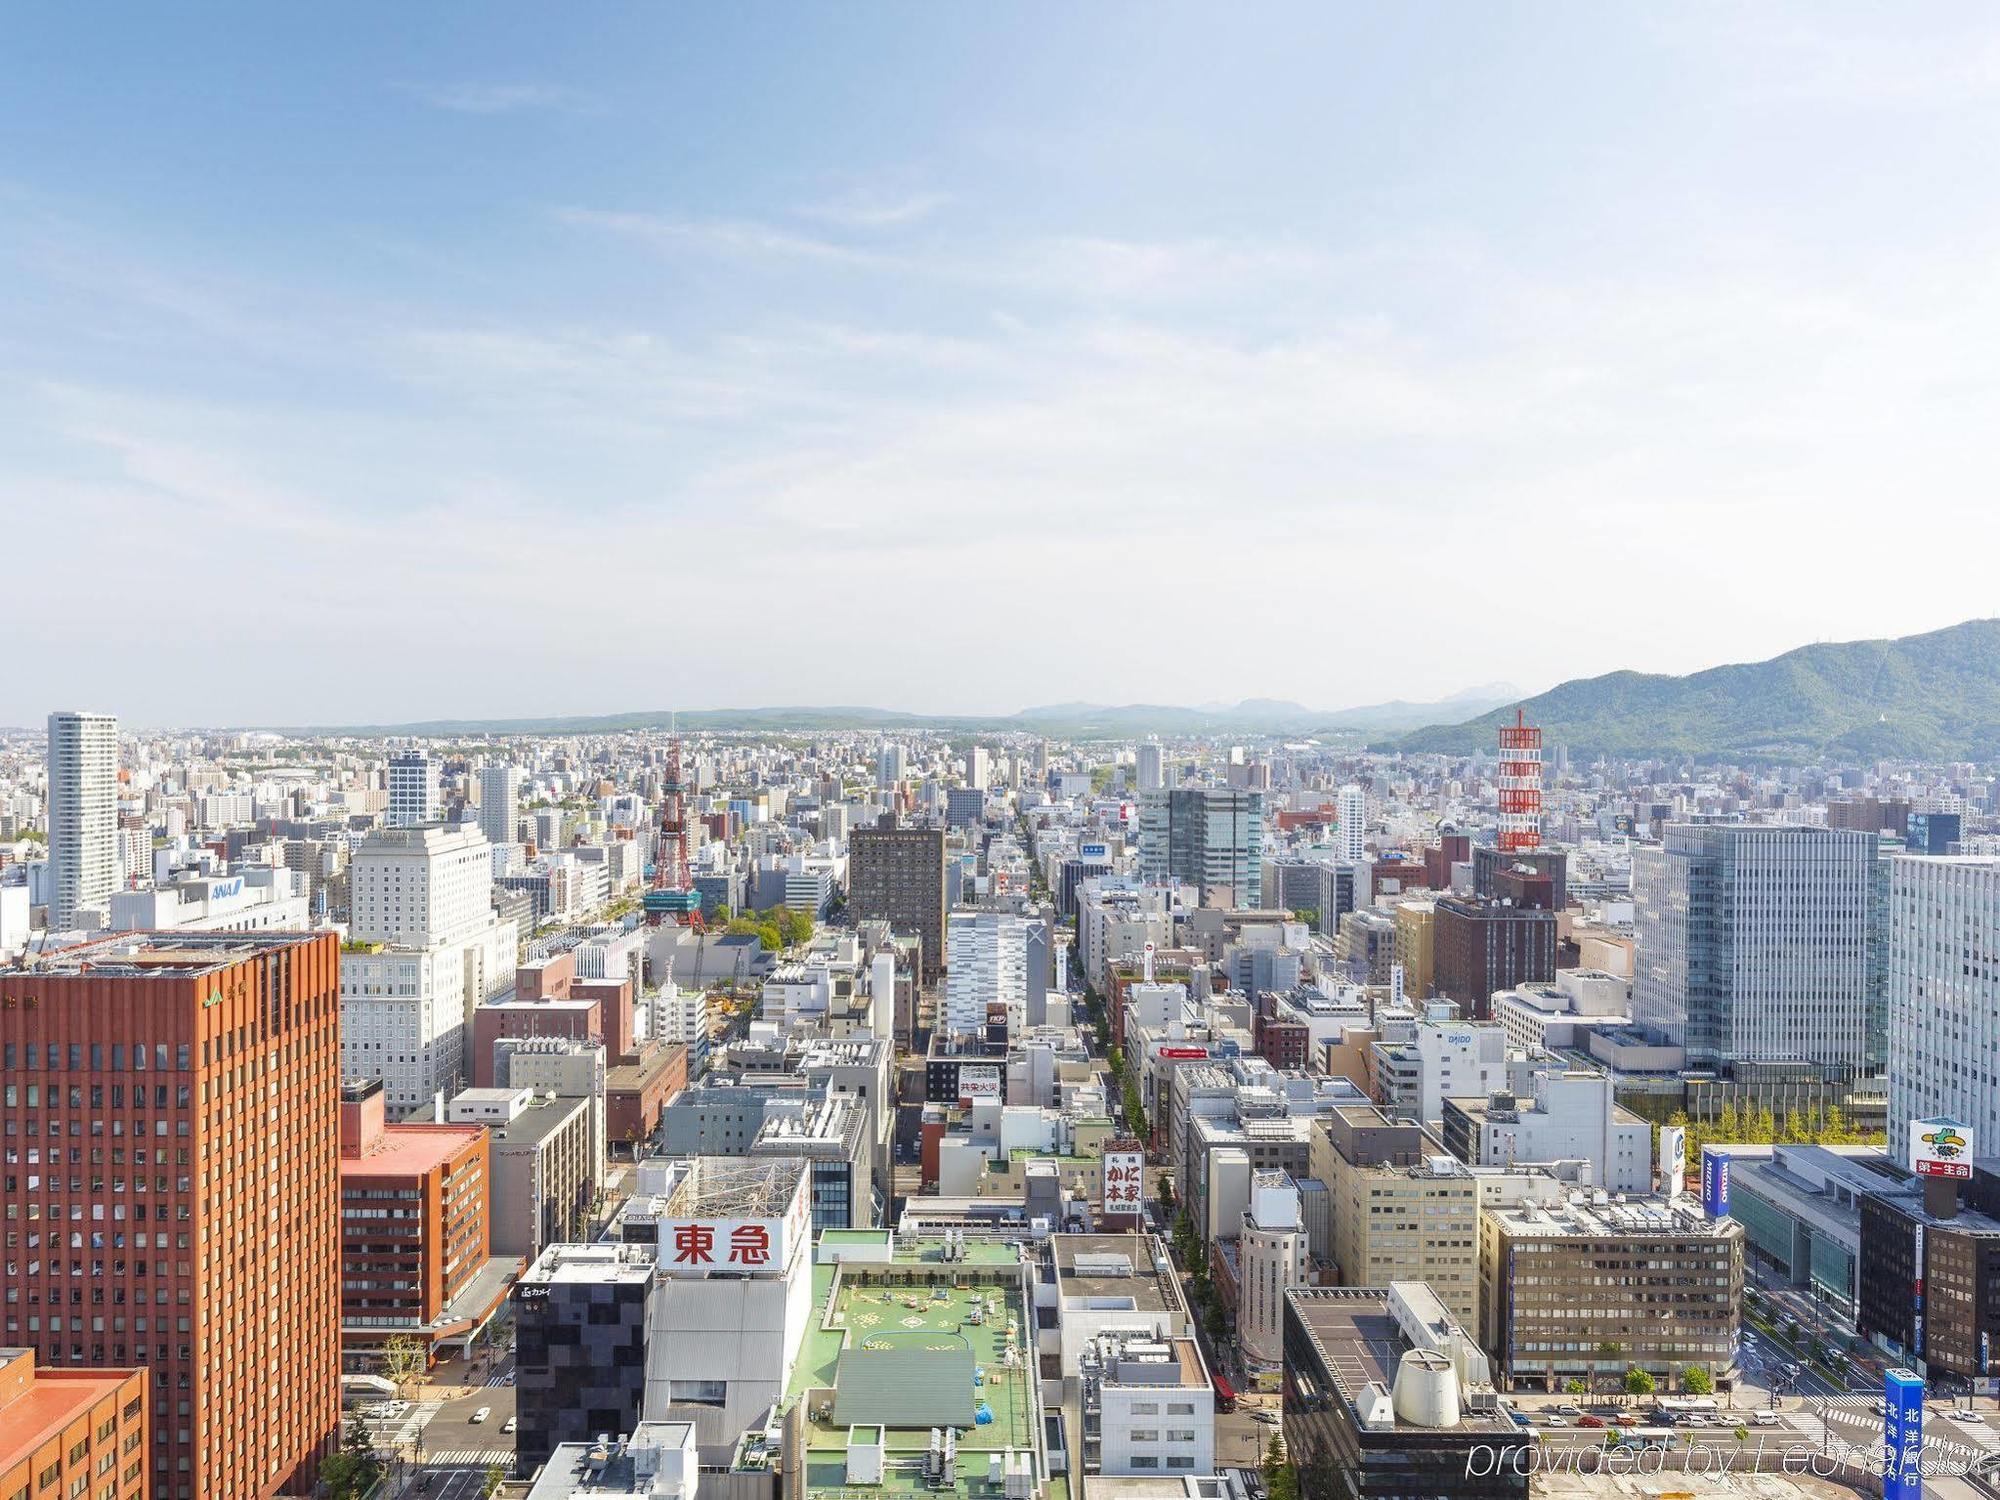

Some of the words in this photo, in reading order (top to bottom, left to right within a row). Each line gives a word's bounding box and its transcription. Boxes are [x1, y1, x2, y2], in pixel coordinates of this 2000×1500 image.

[1107, 1166, 1140, 1182] かに
[1918, 1161, 1968, 1176] 第一生命
[1721, 1162, 1729, 1203] MIZUHO
[1106, 1184, 1140, 1202] 本家
[673, 1224, 771, 1265] 東急
